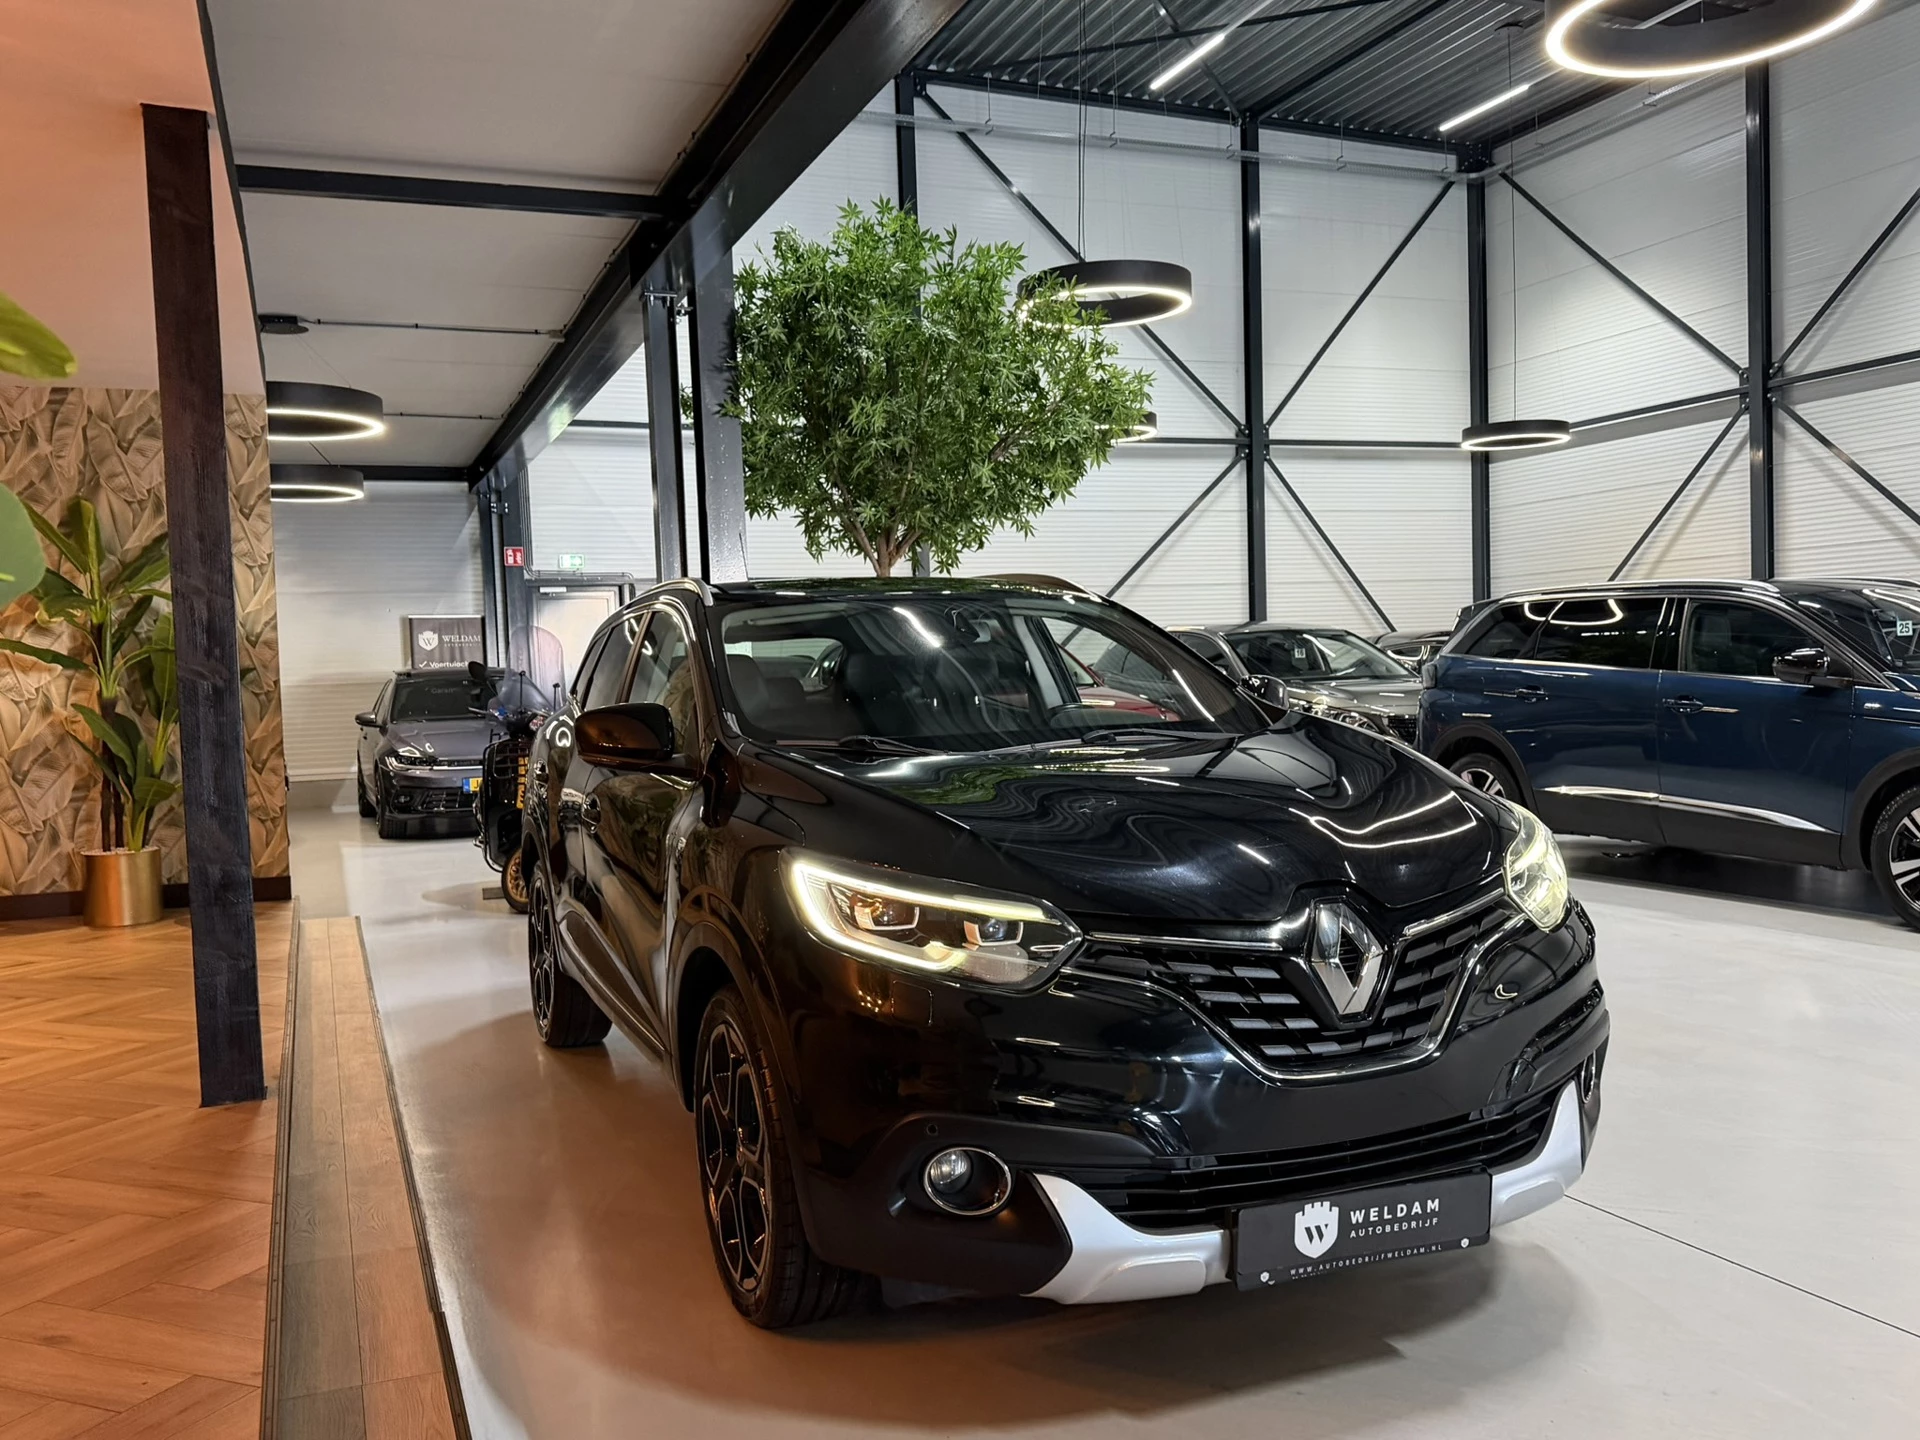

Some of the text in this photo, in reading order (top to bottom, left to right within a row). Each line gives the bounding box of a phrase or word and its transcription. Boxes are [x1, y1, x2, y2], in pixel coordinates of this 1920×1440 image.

[442, 634, 481, 643] WELDAM
[1899, 622, 1911, 634] 25
[1350, 1198, 1440, 1225] WELDAM
[1304, 1223, 1329, 1245] W
[1350, 1217, 1439, 1239] AUTOBEDRIJF
[1290, 1244, 1442, 1276] WWW.AUTOBEDRIJFWELDAM.NL
